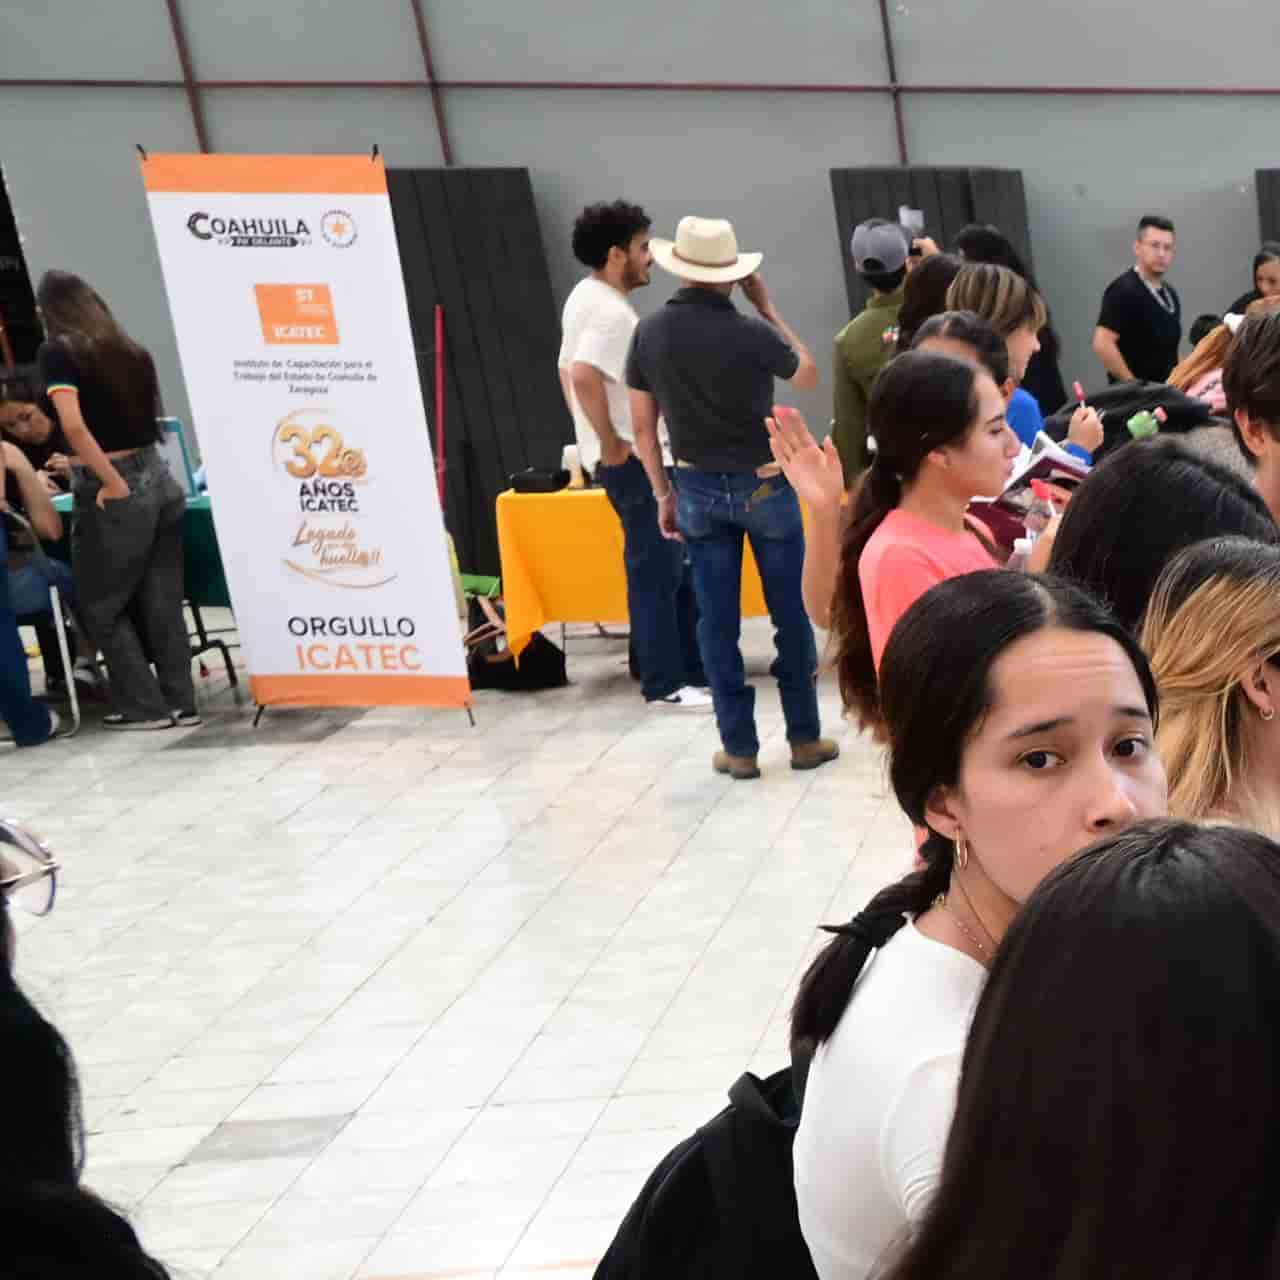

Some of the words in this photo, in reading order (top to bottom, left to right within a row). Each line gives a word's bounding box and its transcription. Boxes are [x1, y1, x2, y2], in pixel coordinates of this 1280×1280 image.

[187, 211, 310, 240] COAHUILA
[280, 424, 344, 479] 32
[300, 479, 354, 497] AÑOS
[300, 498, 359, 512] ICATEC
[288, 616, 416, 637] ORGULLO
[296, 643, 422, 671] ICATEC
